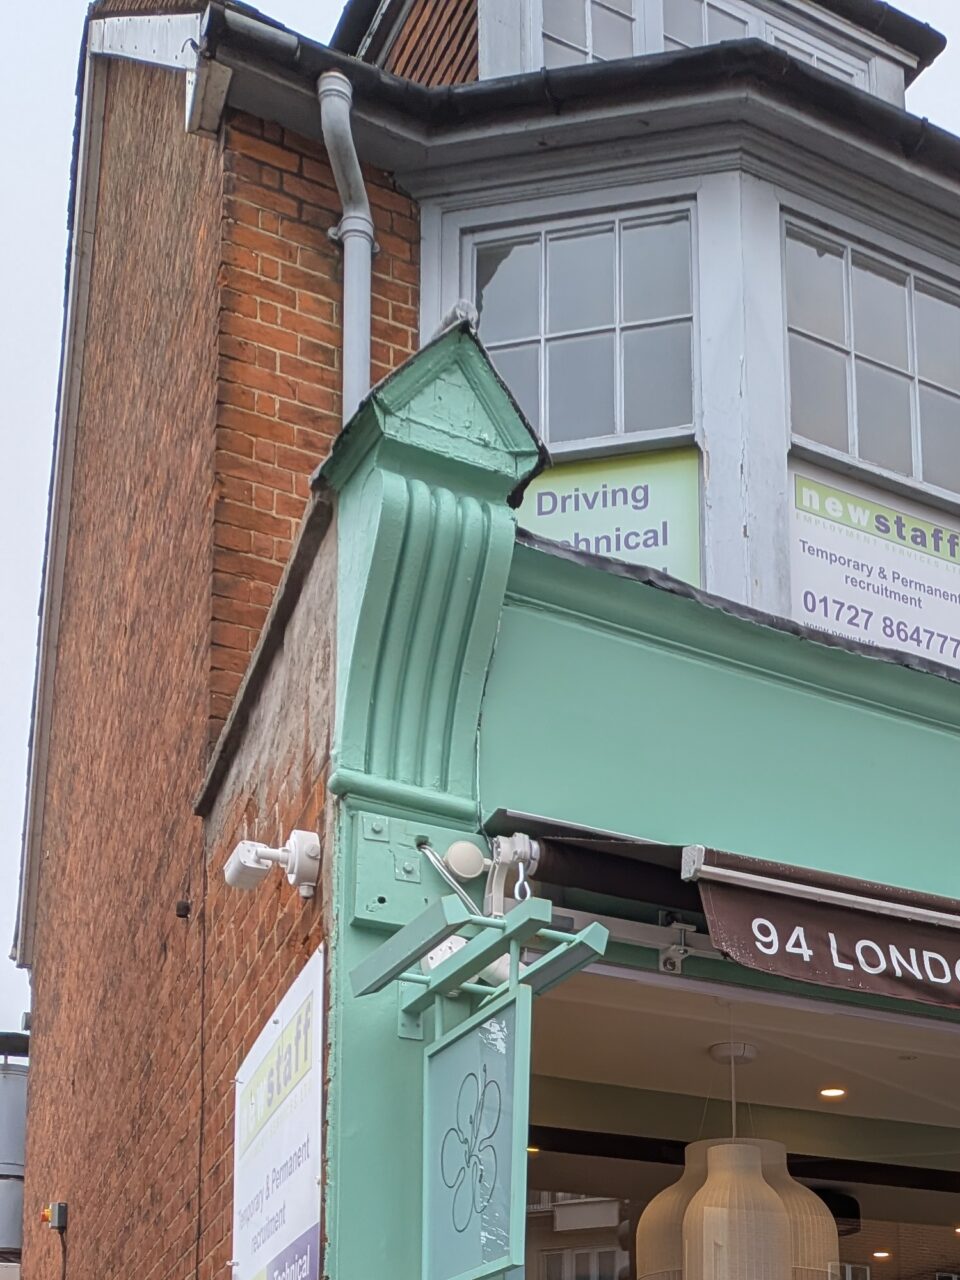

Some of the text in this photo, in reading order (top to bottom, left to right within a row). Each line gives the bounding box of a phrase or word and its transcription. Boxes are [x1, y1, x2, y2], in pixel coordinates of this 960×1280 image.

[537, 484, 649, 516] Driving
[562, 521, 668, 553] hnical
[802, 487, 959, 558] newstaff
[800, 540, 873, 577] Temporary
[878, 567, 888, 580] &
[803, 591, 873, 630] 01727
[845, 574, 922, 608] recruitment
[751, 917, 813, 962] 94
[272, 1133, 310, 1194] Permanent
[251, 1200, 286, 1254] recruitment
